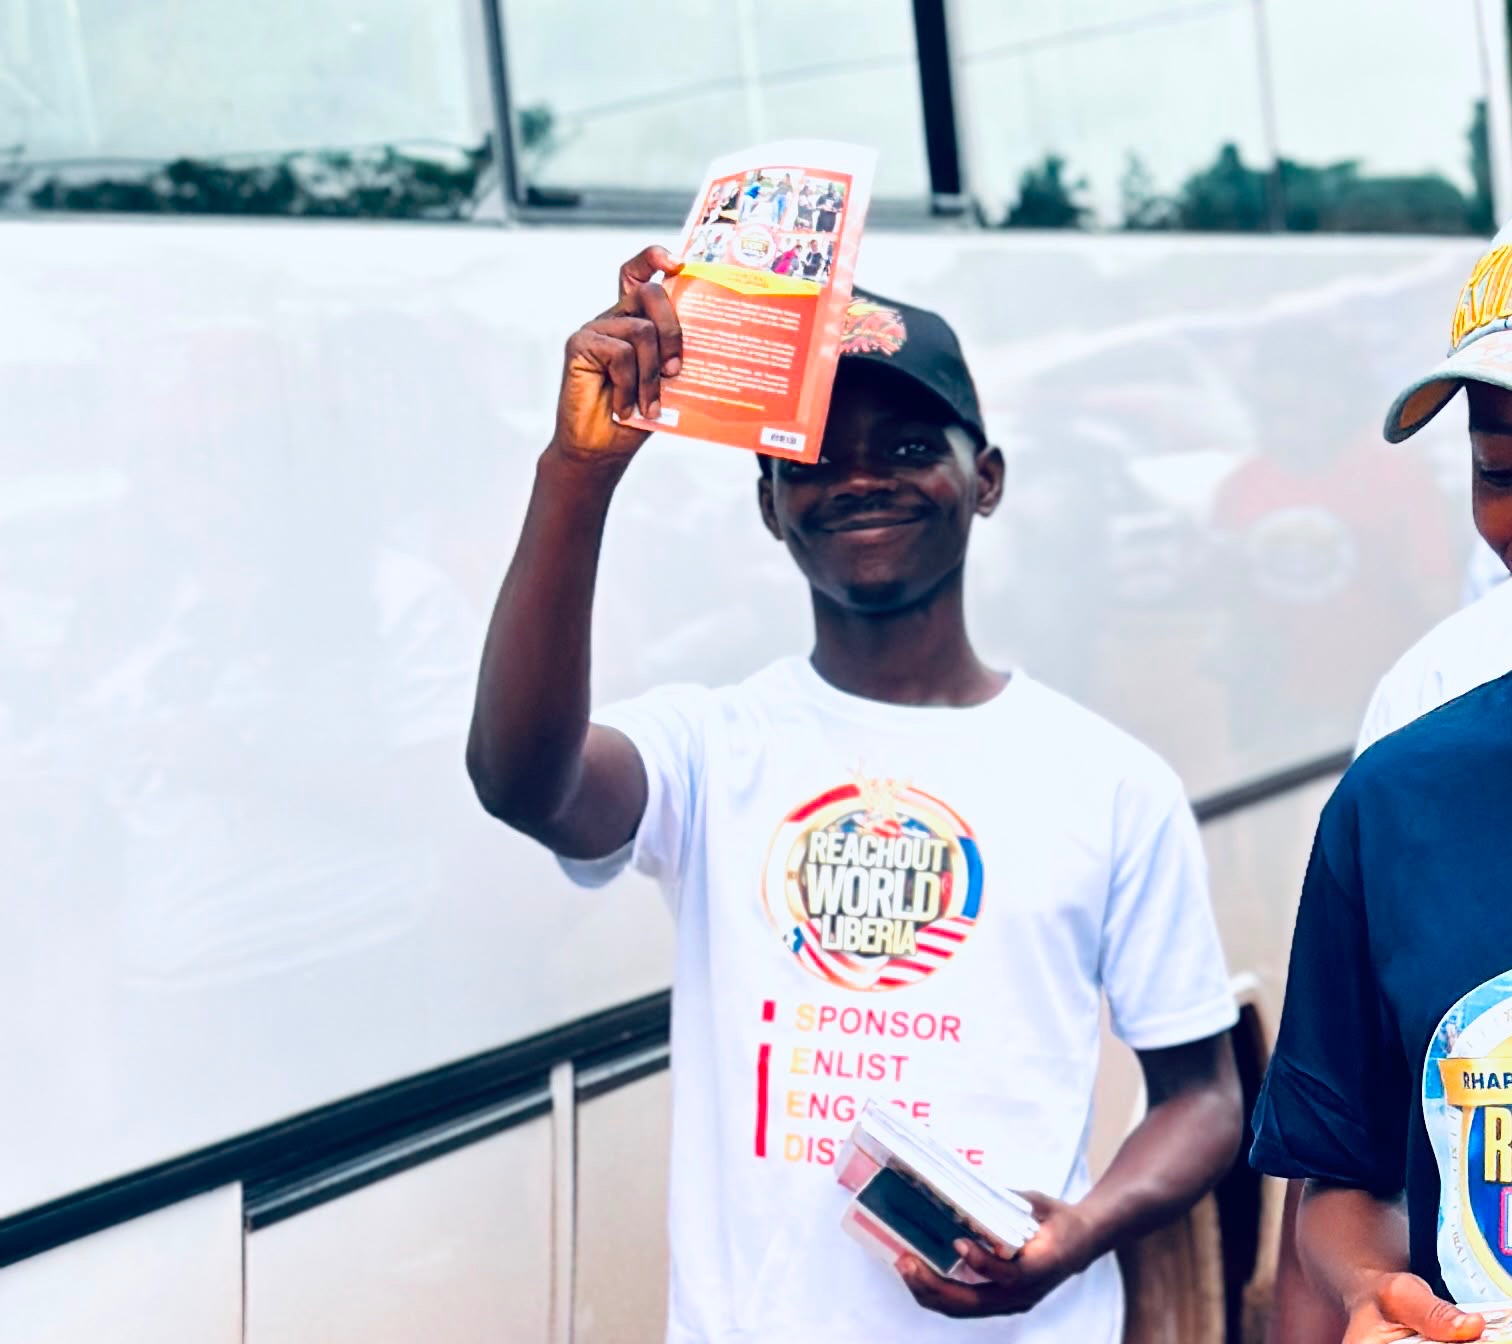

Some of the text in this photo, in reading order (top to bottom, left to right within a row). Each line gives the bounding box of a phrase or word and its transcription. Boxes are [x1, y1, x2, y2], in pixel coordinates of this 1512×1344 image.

[808, 831, 948, 873] REACHOUT
[806, 863, 941, 922] WORLD
[821, 914, 917, 956] LIBERIA
[794, 1003, 961, 1043] SPONSOR
[789, 1046, 910, 1082] ENLIST
